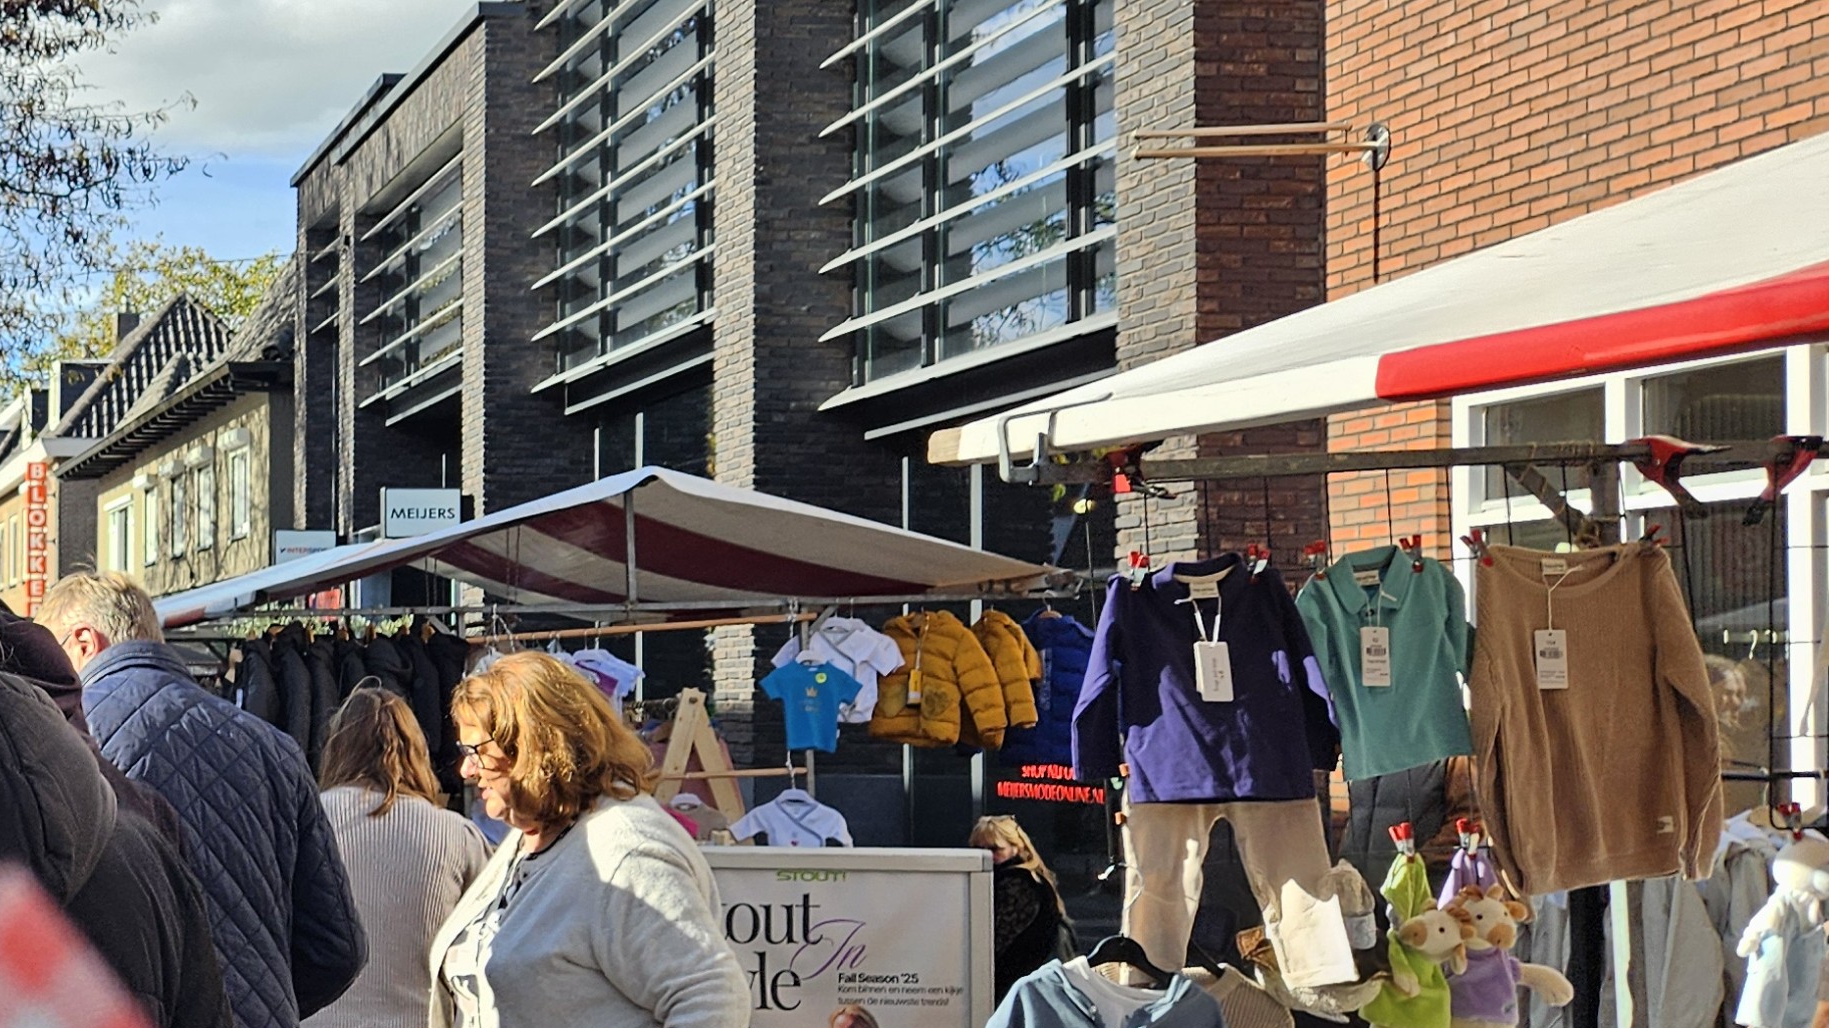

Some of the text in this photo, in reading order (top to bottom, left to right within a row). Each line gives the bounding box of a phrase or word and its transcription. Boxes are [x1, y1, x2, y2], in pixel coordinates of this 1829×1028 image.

[390, 507, 456, 520] MEIJERS
[776, 869, 850, 882] STOUT!
[721, 893, 825, 946] out
[747, 951, 804, 1011] le
[837, 972, 857, 984] Fall
[858, 972, 899, 984] Season
[837, 985, 857, 994] Kom
[857, 985, 887, 994] binnen
